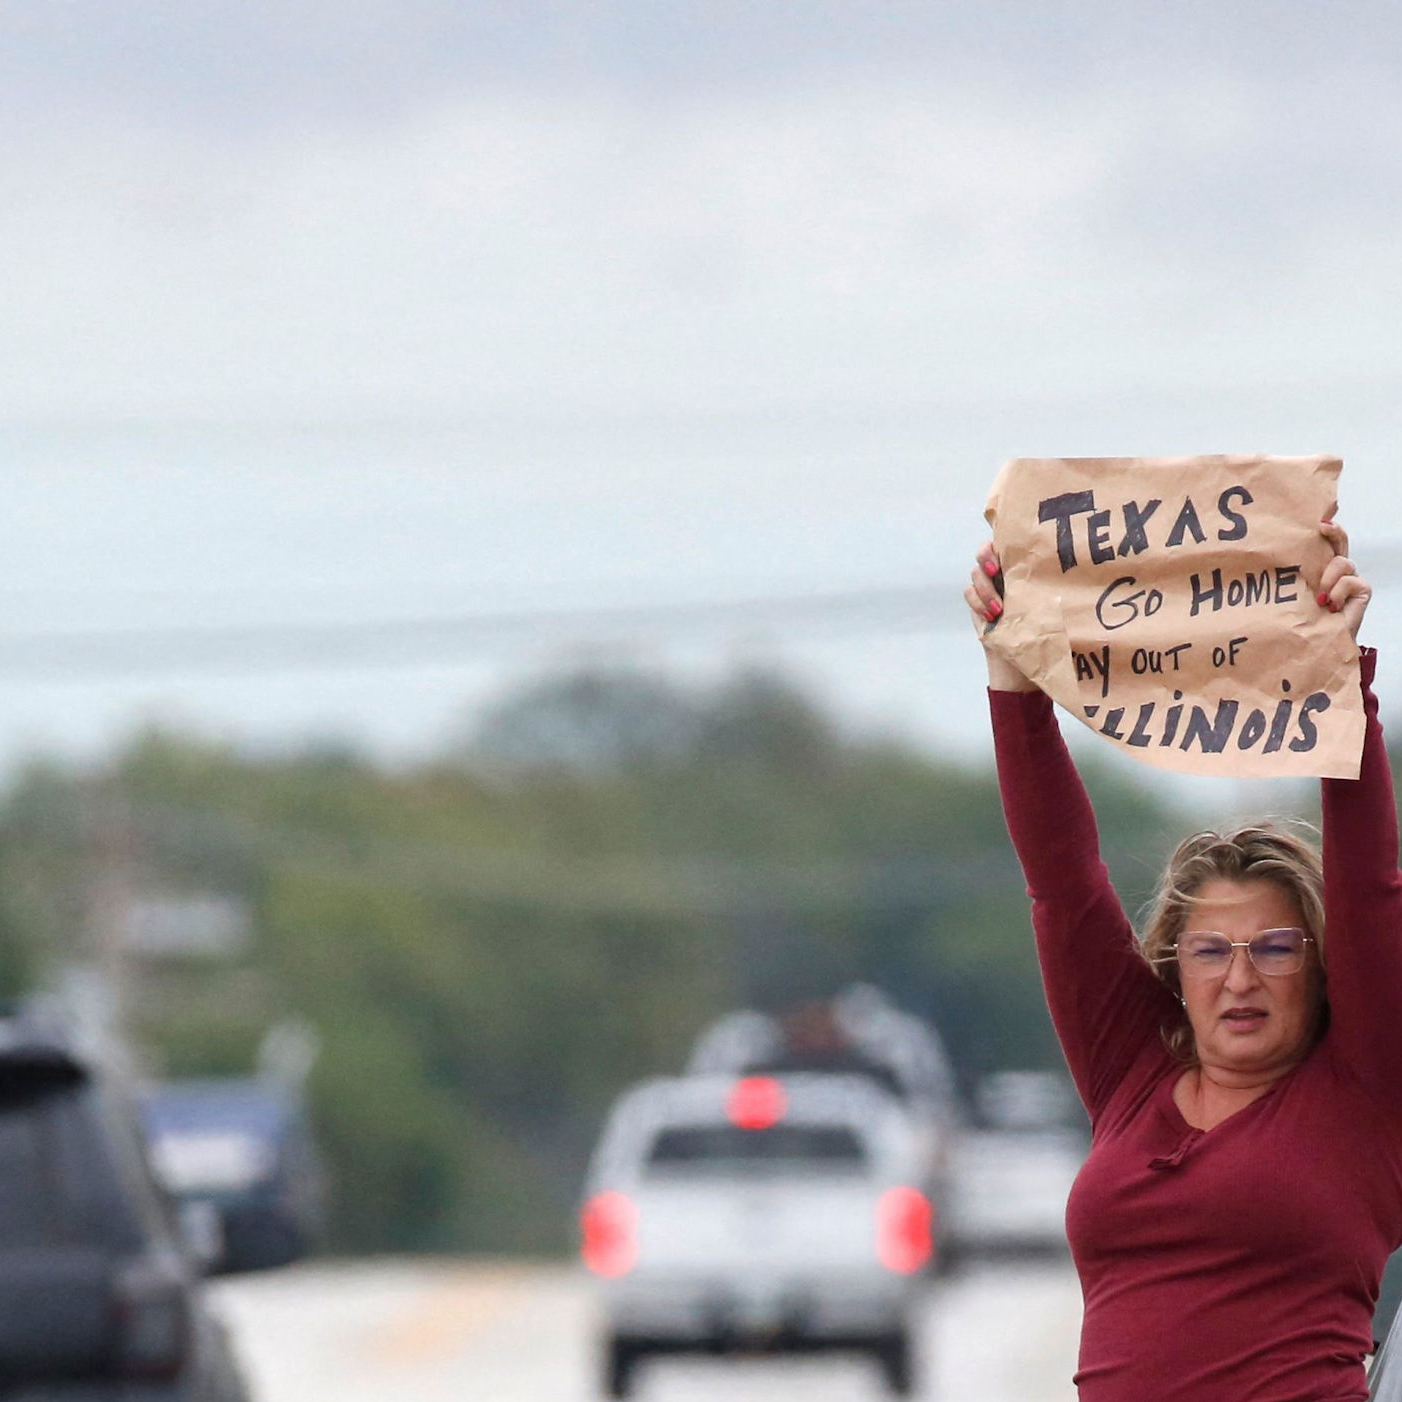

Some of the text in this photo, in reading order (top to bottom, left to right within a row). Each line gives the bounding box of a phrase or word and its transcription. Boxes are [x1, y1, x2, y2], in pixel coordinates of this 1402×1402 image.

[1038, 486, 1254, 573] TEXAS
[1190, 565, 1300, 616] HOME
[1071, 637, 1248, 698] AY OUT OF
